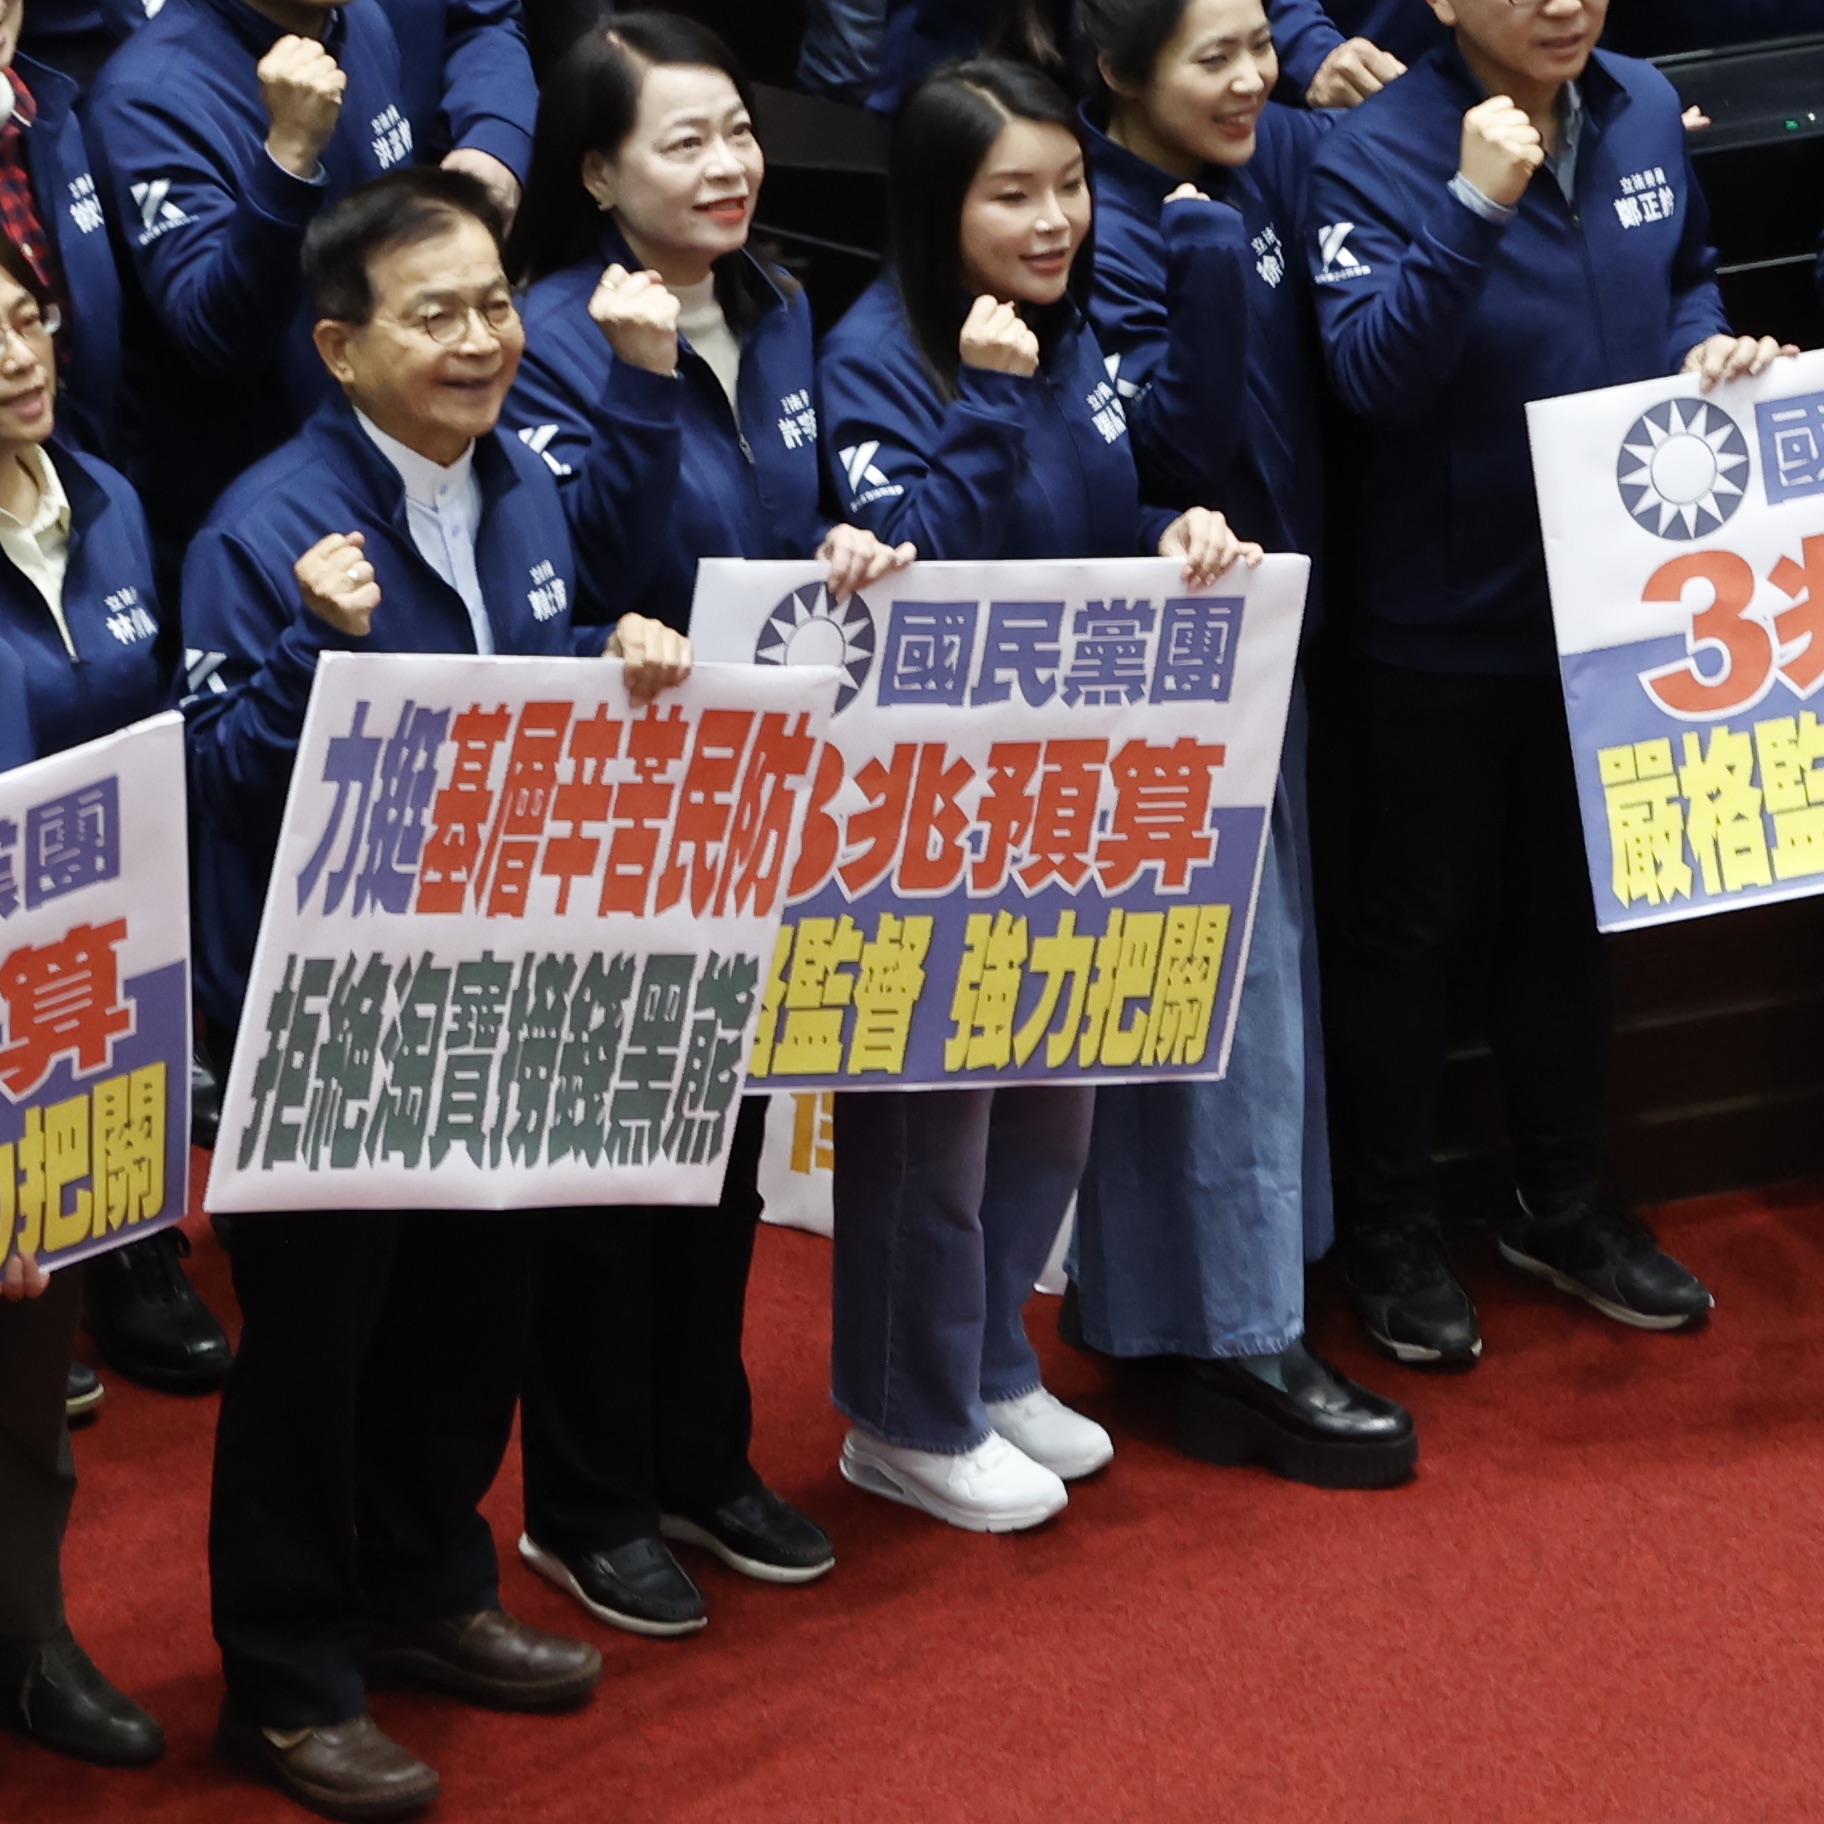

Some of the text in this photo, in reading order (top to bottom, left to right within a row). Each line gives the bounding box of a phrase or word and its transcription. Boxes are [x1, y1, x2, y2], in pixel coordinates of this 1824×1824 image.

[876, 596, 1247, 709] 國民黨團
[237, 949, 760, 1172] 拒絕淘寶撈錢黑熊
[944, 903, 1233, 1075] 強力把關
